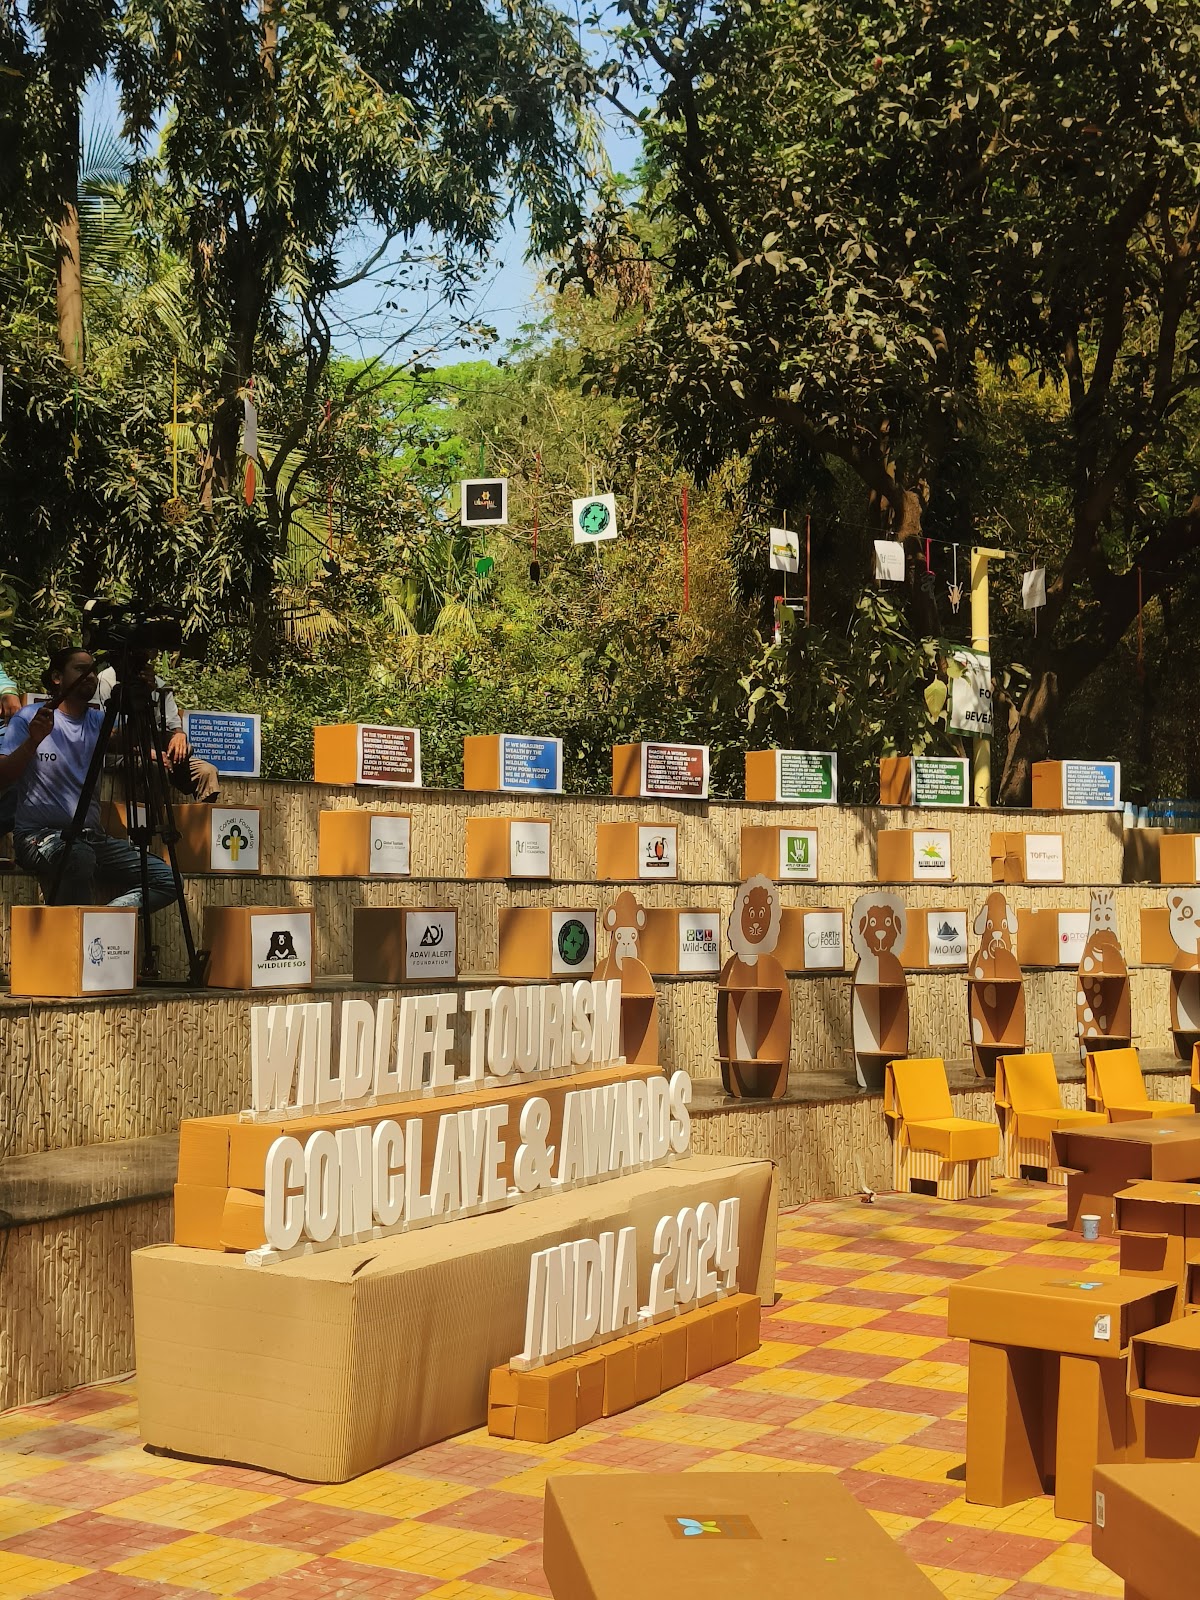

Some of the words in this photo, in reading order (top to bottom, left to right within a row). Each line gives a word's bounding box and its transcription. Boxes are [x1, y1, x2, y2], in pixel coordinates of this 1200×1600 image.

[683, 943, 716, 952] Wild-CER
[935, 944, 961, 954] MOYO
[251, 992, 458, 1111] WILDLIFE
[466, 979, 622, 1080] TOURISM
[264, 1104, 509, 1250] CONCLAVE
[514, 1097, 555, 1192] &
[558, 1070, 692, 1183] AWARDS
[524, 1226, 638, 1360] INDIA
[649, 1198, 740, 1314] 2024
